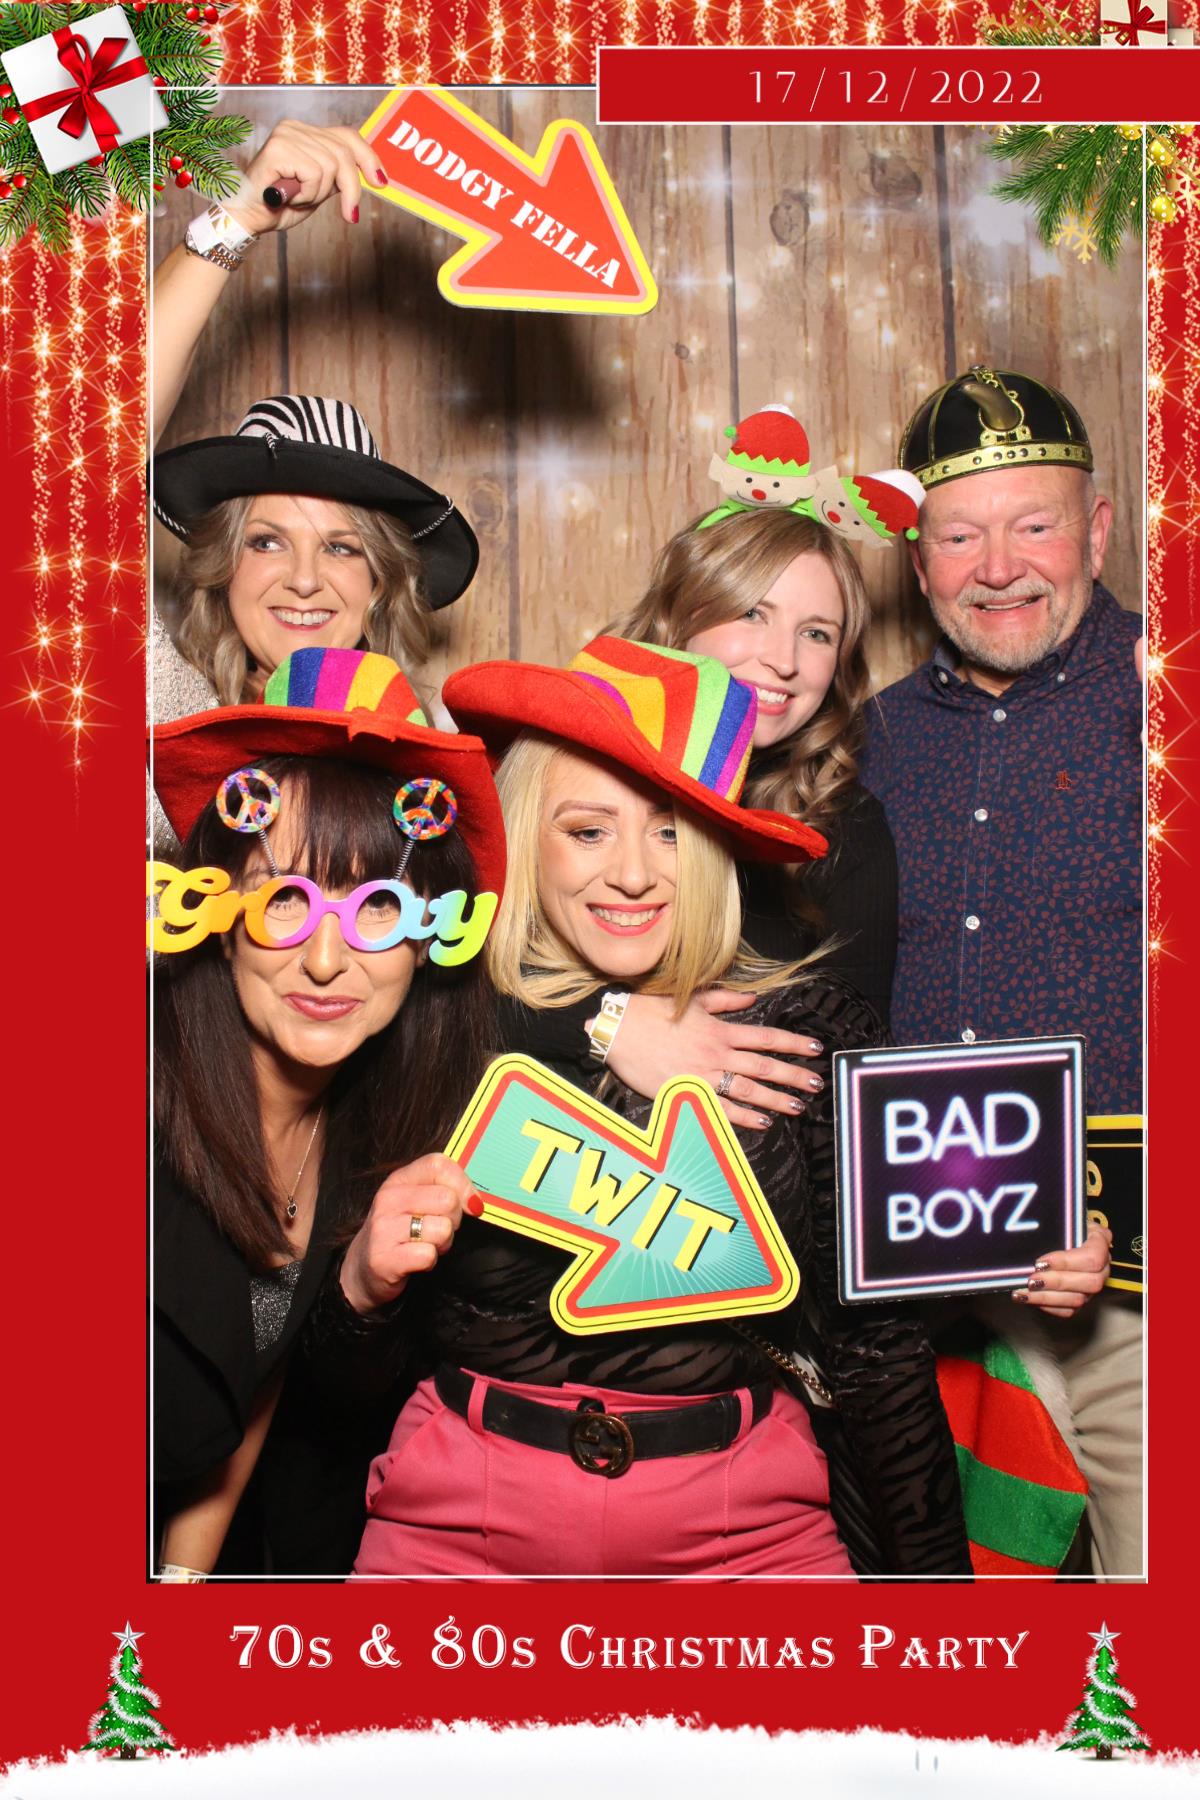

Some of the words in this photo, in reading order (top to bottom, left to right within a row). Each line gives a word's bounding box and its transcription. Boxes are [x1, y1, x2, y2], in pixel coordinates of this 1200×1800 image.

[387, 119, 515, 211] DODGY
[509, 199, 622, 289] FELLA
[885, 1092, 1041, 1165] BAD
[519, 1118, 739, 1273] TWIT
[888, 1182, 1040, 1242] BOYZ
